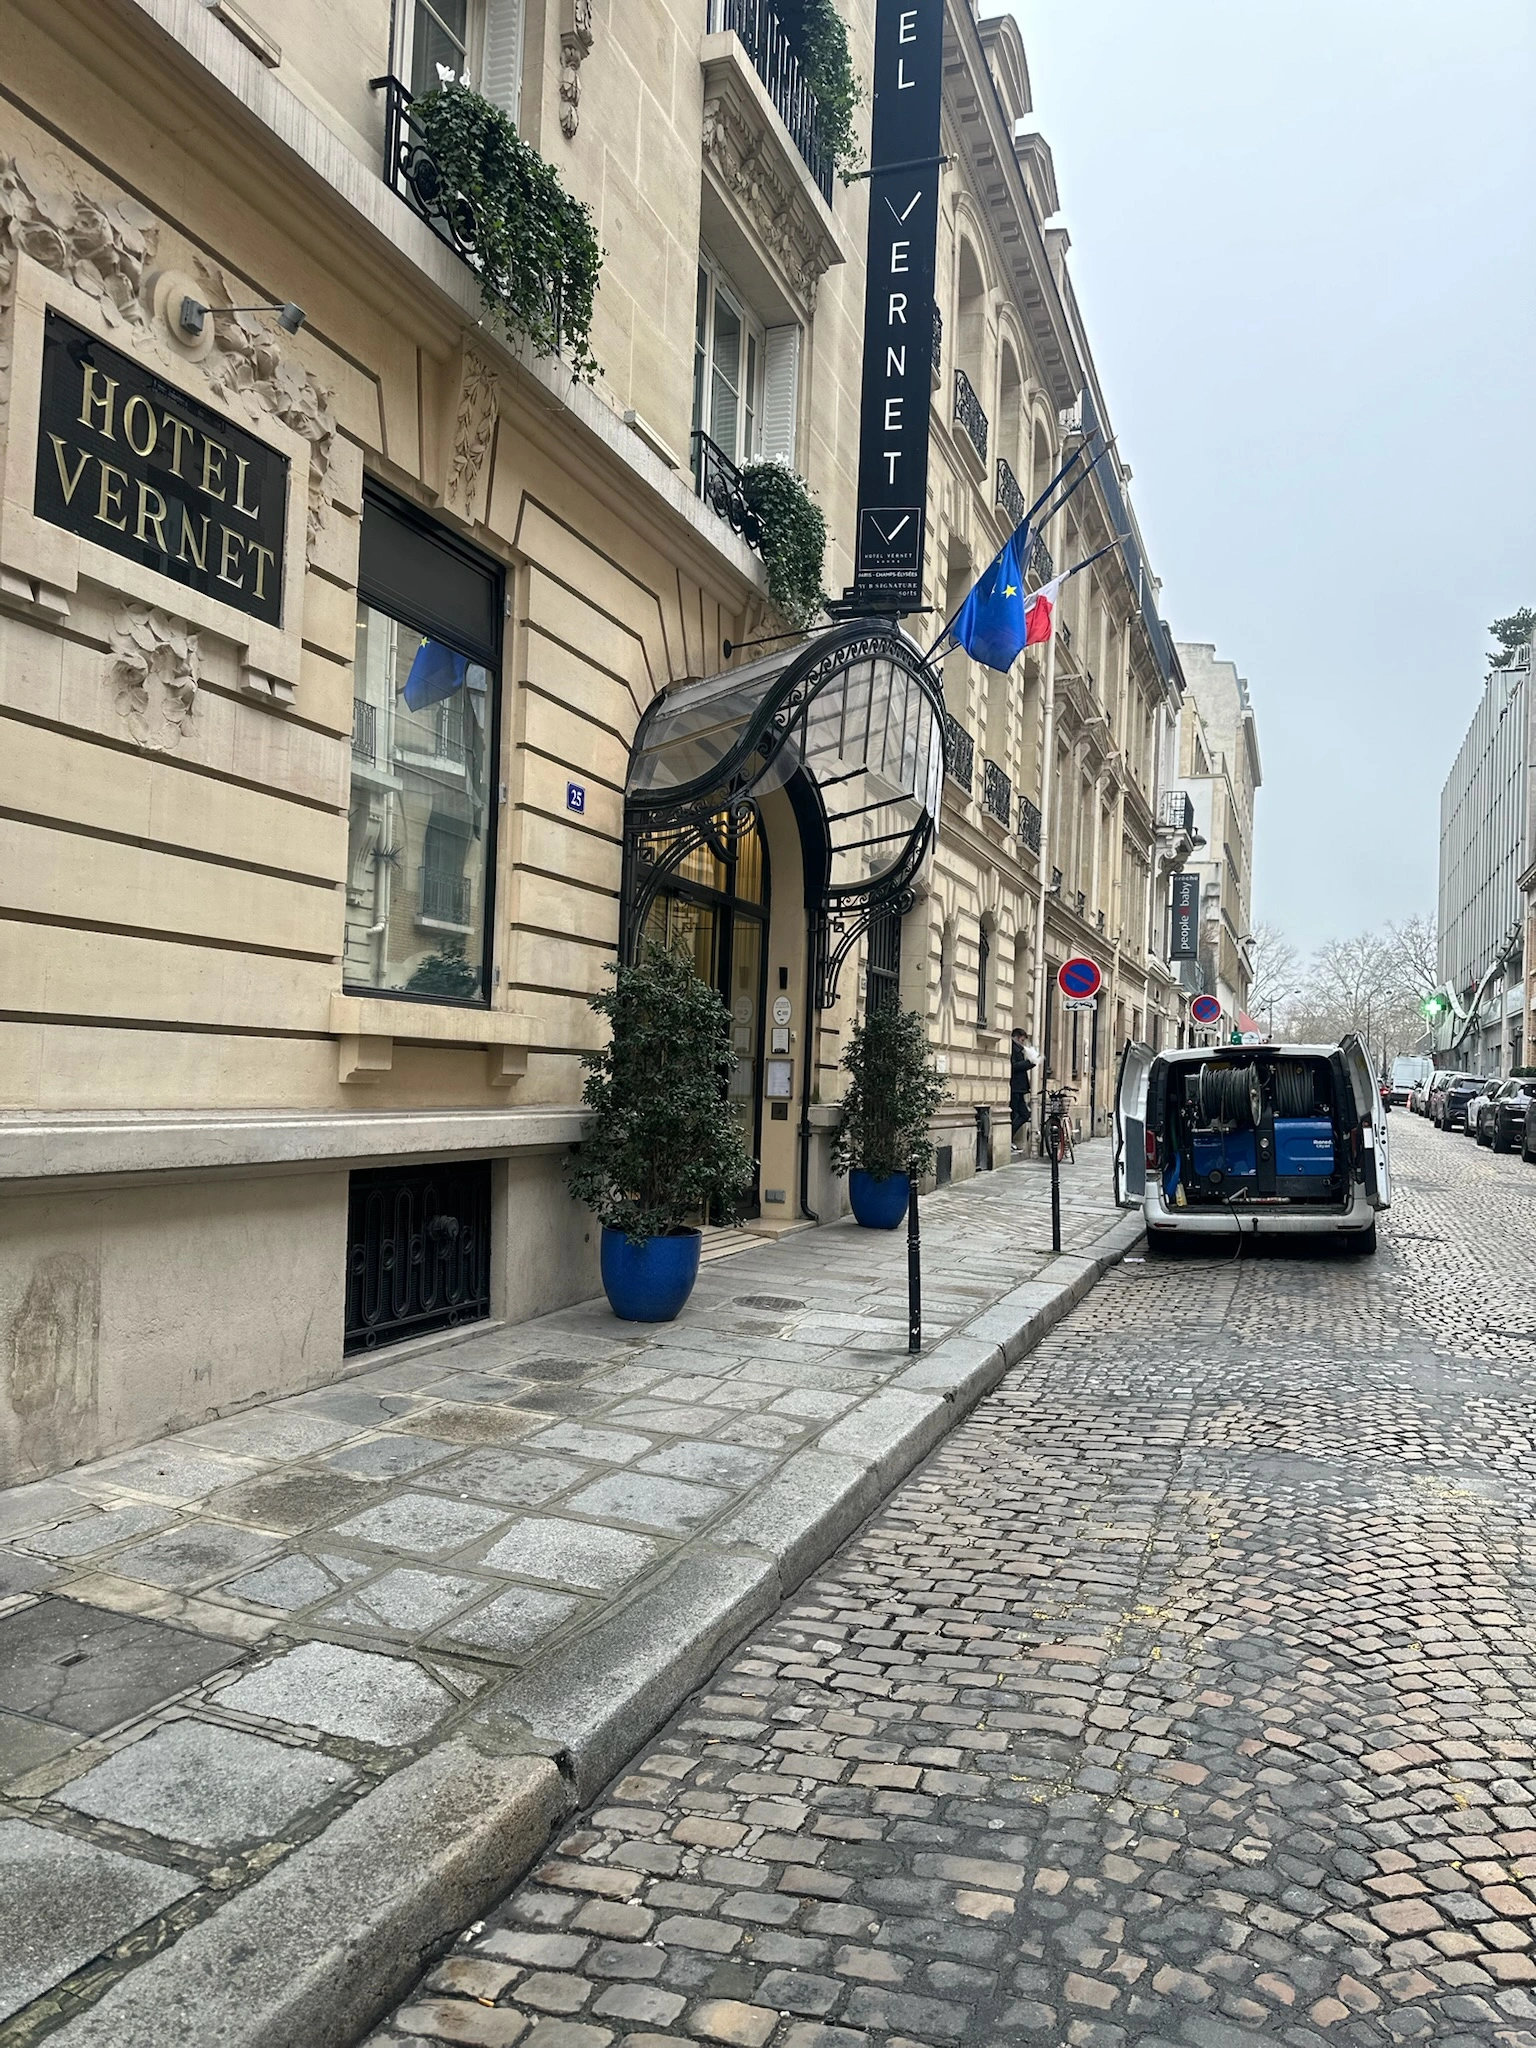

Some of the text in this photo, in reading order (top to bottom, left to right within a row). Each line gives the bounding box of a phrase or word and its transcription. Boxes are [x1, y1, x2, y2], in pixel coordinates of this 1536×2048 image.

[883, 191, 922, 485] VERNET
[46, 431, 276, 600] VERNET
[77, 360, 260, 520] HOTEL
[570, 789, 583, 807] 25
